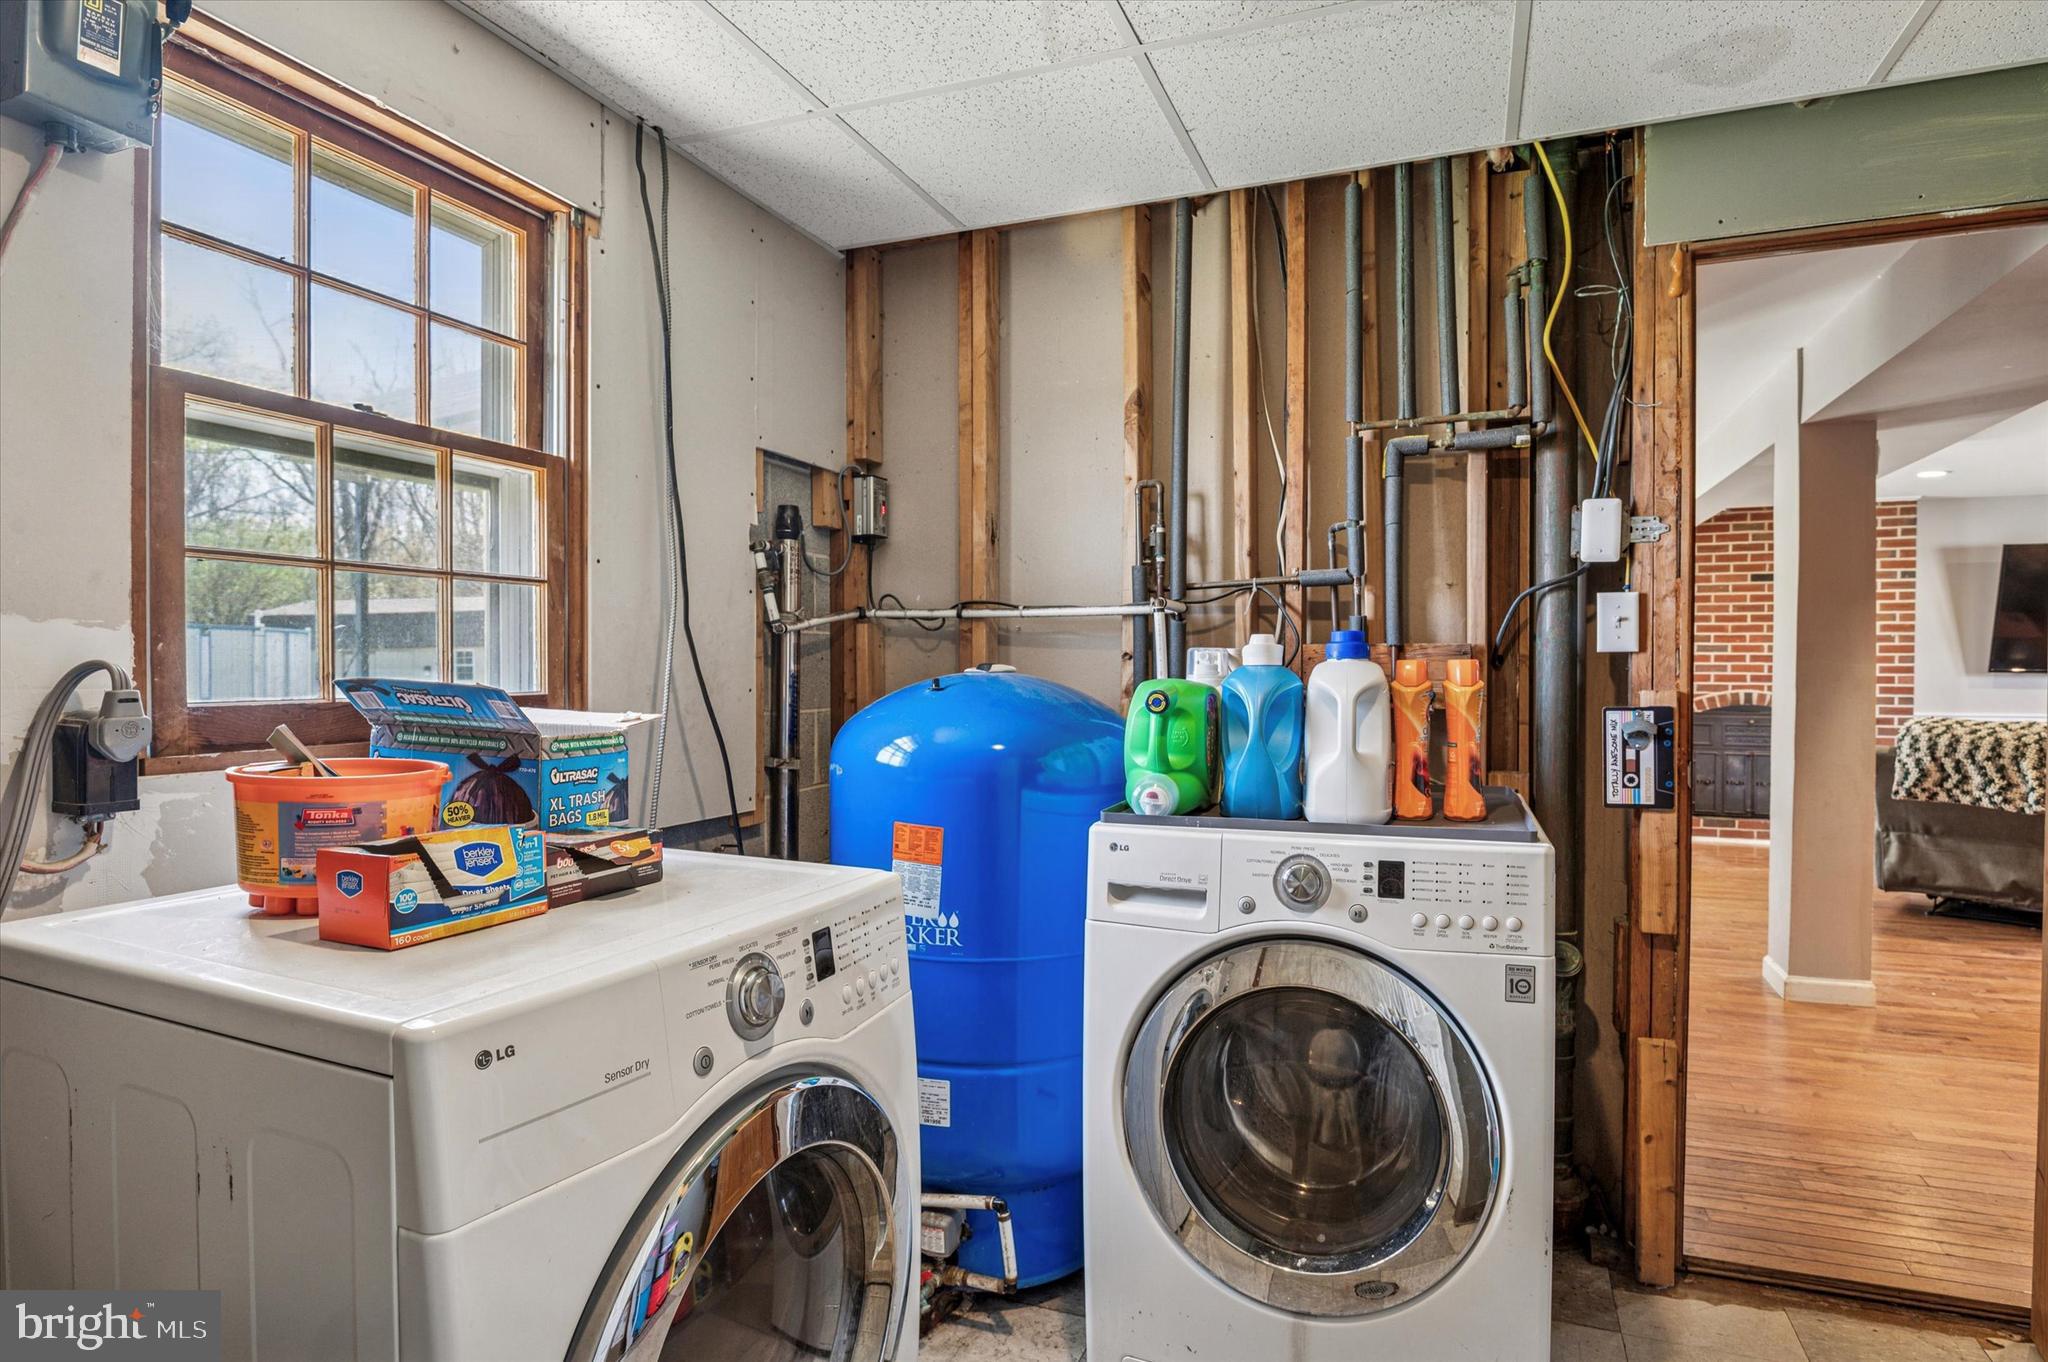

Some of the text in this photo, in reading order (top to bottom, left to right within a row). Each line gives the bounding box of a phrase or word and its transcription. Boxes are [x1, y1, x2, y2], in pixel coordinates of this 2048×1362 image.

[397, 693, 473, 714] ULTRASAC
[1610, 719, 1619, 798] TOTALLY AWESOME MIX
[550, 767, 598, 784] ULTRASAC
[550, 791, 606, 811] XL TRASH
[306, 810, 348, 819] Tonka
[447, 806, 469, 816] 50%
[447, 814, 471, 823] HEAVIER
[550, 810, 582, 827] BAGS
[463, 847, 495, 858] berkley
[1177, 876, 1192, 884] Drive
[395, 935, 411, 945] 160
[906, 926, 963, 947] RKER
[707, 978, 725, 987] NORMAL
[1509, 978, 1531, 994] 10
[496, 1045, 515, 1061] LG
[604, 1058, 651, 1084] Sensor Dry
